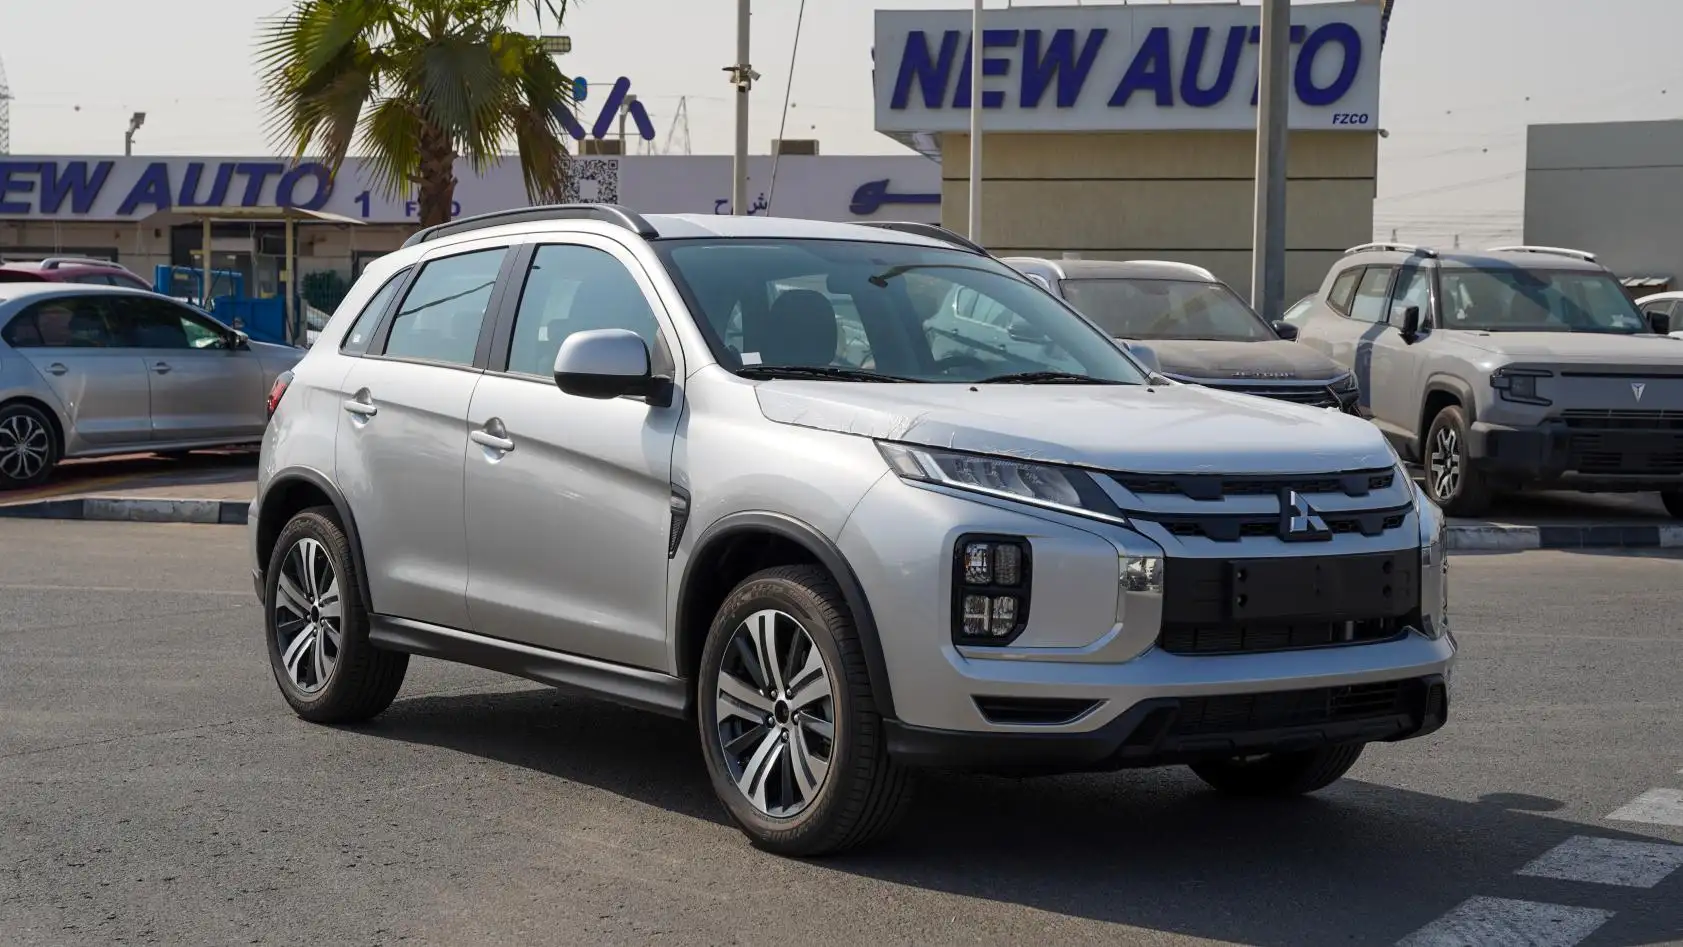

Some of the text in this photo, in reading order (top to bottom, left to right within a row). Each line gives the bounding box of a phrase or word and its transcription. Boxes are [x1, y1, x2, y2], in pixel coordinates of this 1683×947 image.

[890, 22, 1362, 109] NEW AUO
[1332, 113, 1369, 124] FZCO
[0, 161, 114, 213] EW
[115, 162, 335, 215] AUTO
[354, 190, 370, 217] 1
